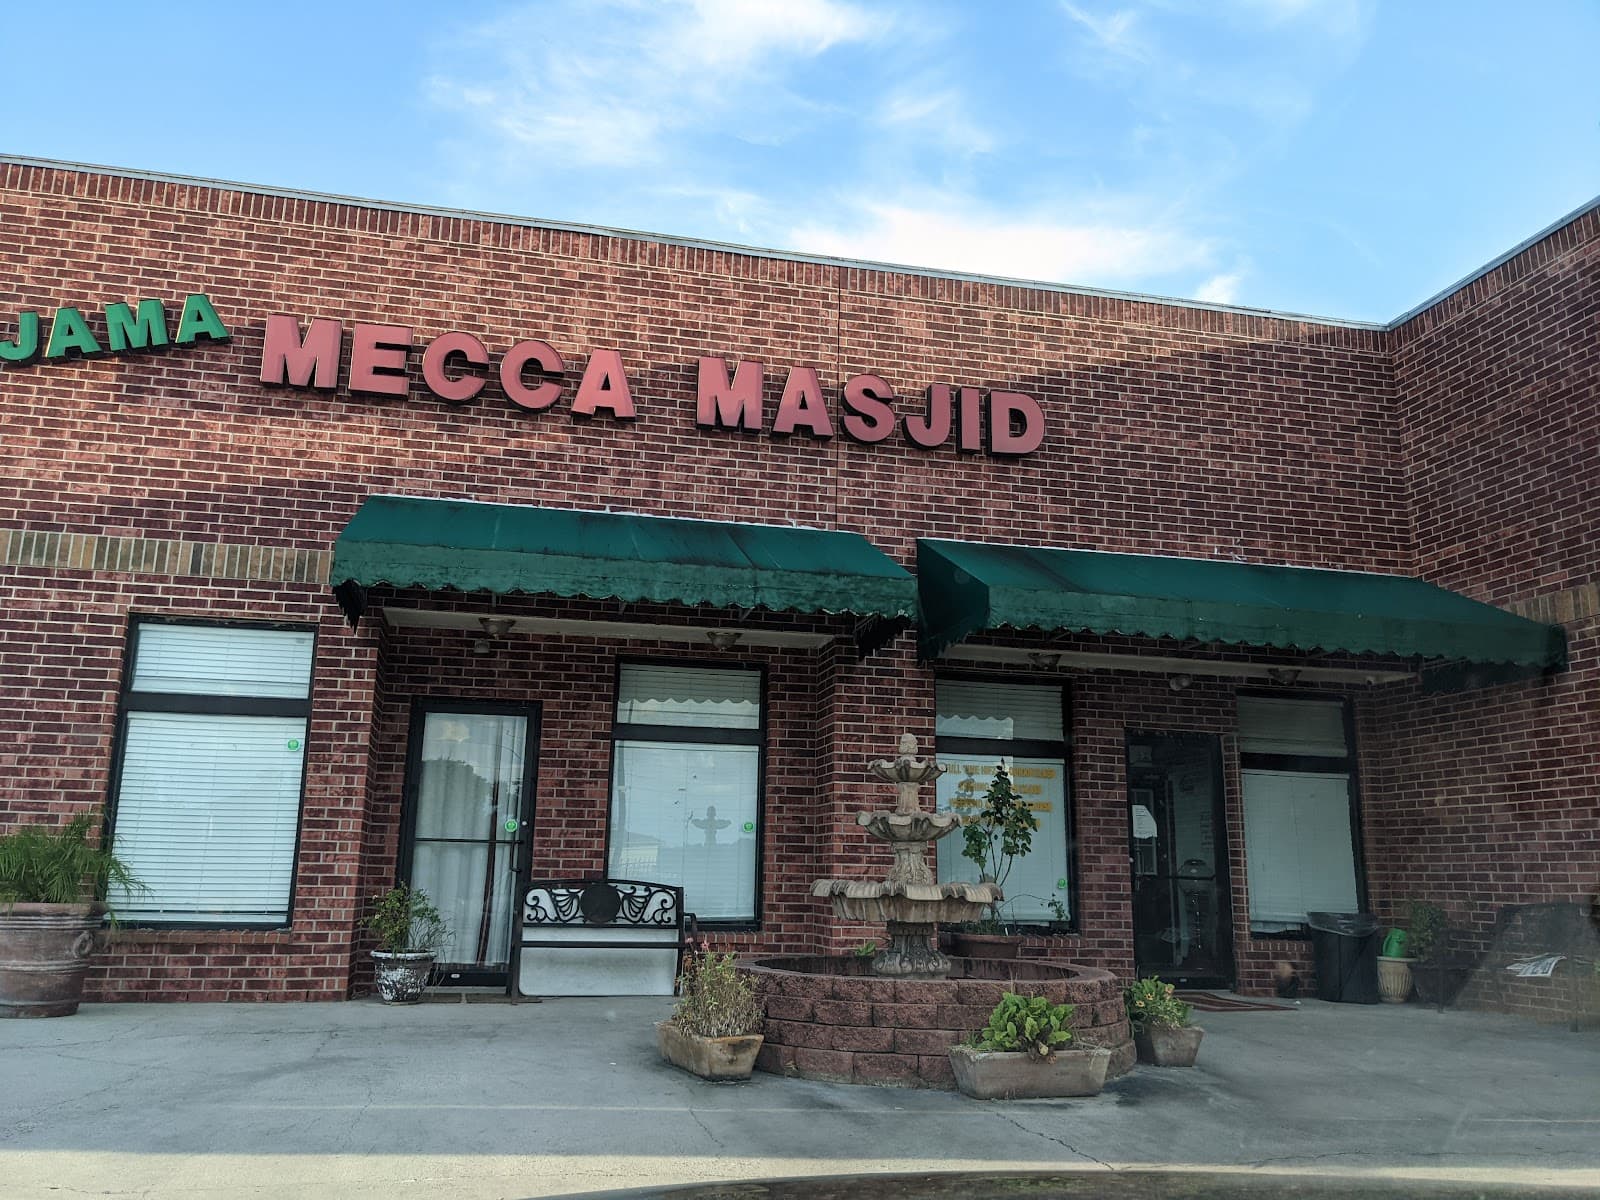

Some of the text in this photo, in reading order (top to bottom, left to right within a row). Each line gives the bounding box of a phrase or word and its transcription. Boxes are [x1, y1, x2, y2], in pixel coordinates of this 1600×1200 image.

[0, 294, 231, 363] JAMA
[259, 313, 1046, 455] MECCA MASJID
